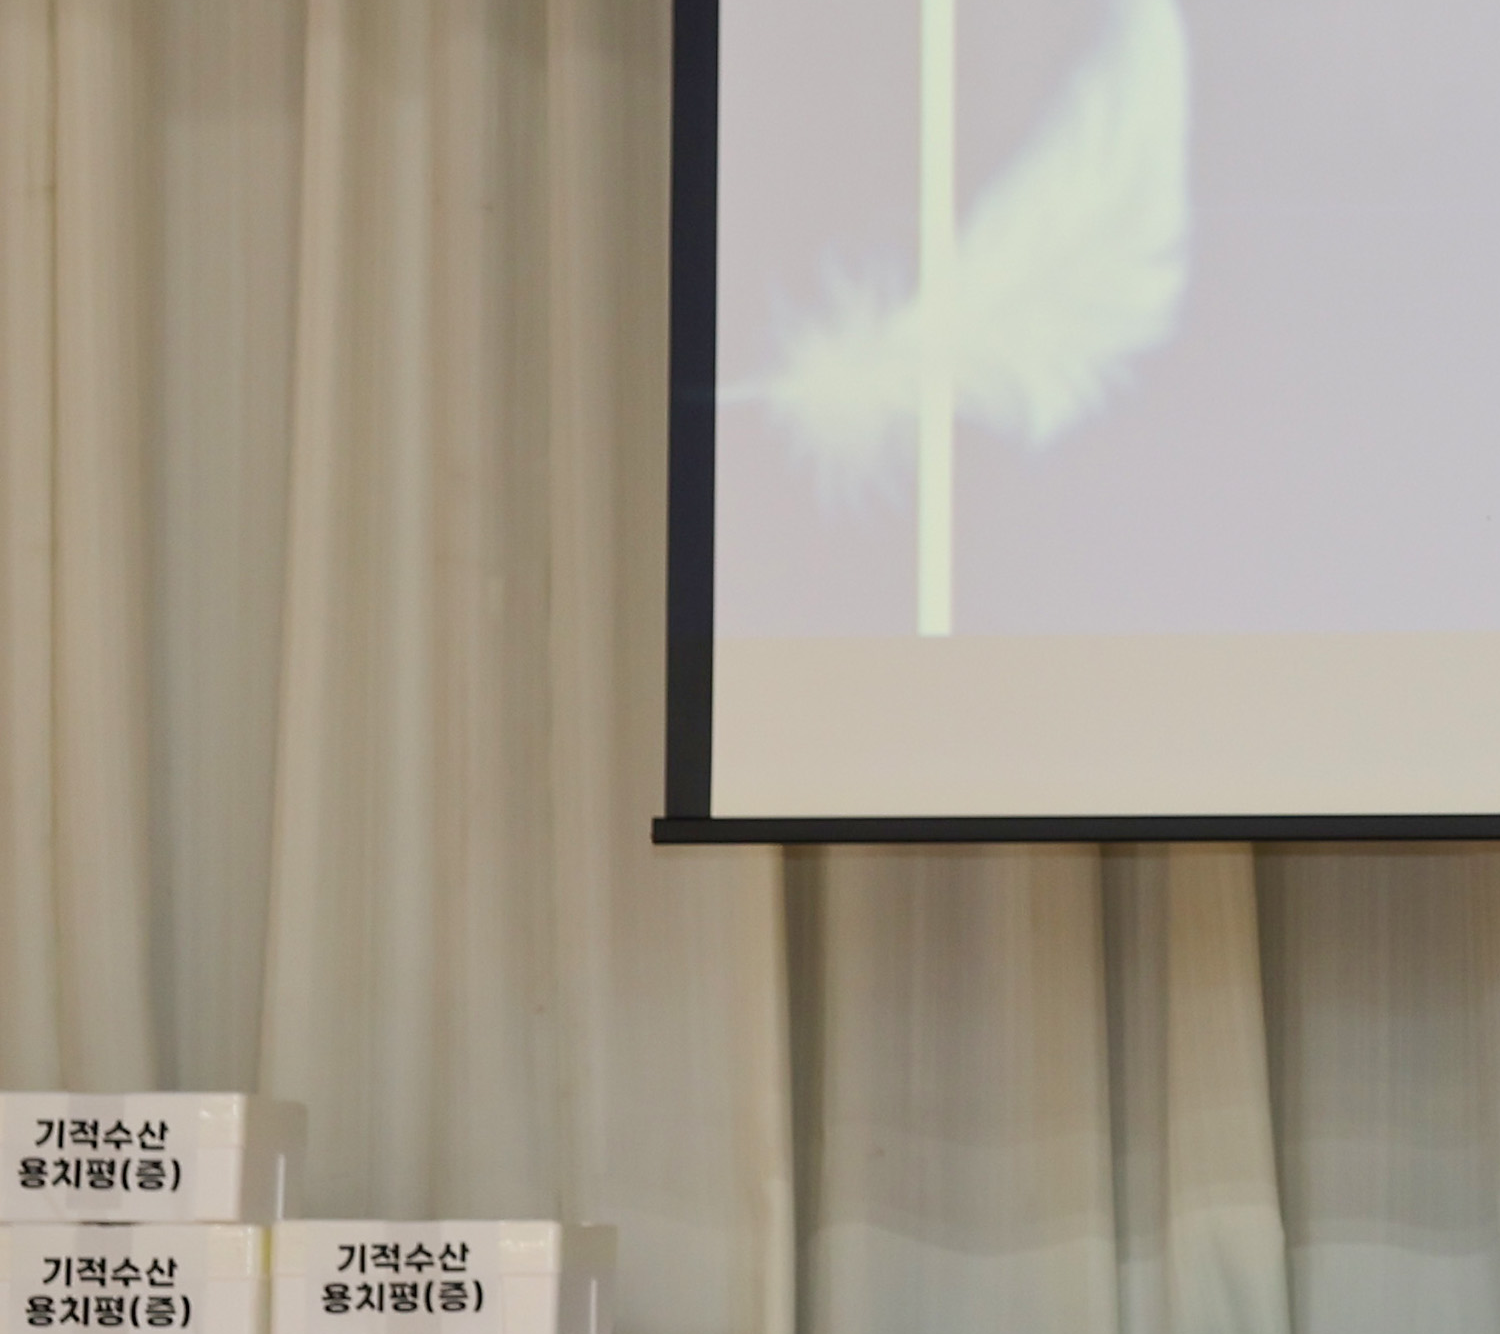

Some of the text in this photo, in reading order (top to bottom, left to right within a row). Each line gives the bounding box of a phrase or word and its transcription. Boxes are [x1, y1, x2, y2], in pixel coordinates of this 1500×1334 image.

[36, 1120, 168, 1150] 기적수산
[19, 1158, 180, 1191] 용치평(증)
[43, 1258, 177, 1287] 기적수산
[338, 1243, 469, 1274] 기적수산
[26, 1296, 190, 1327] 용치평(증)
[322, 1280, 483, 1313] 용치평(증)
